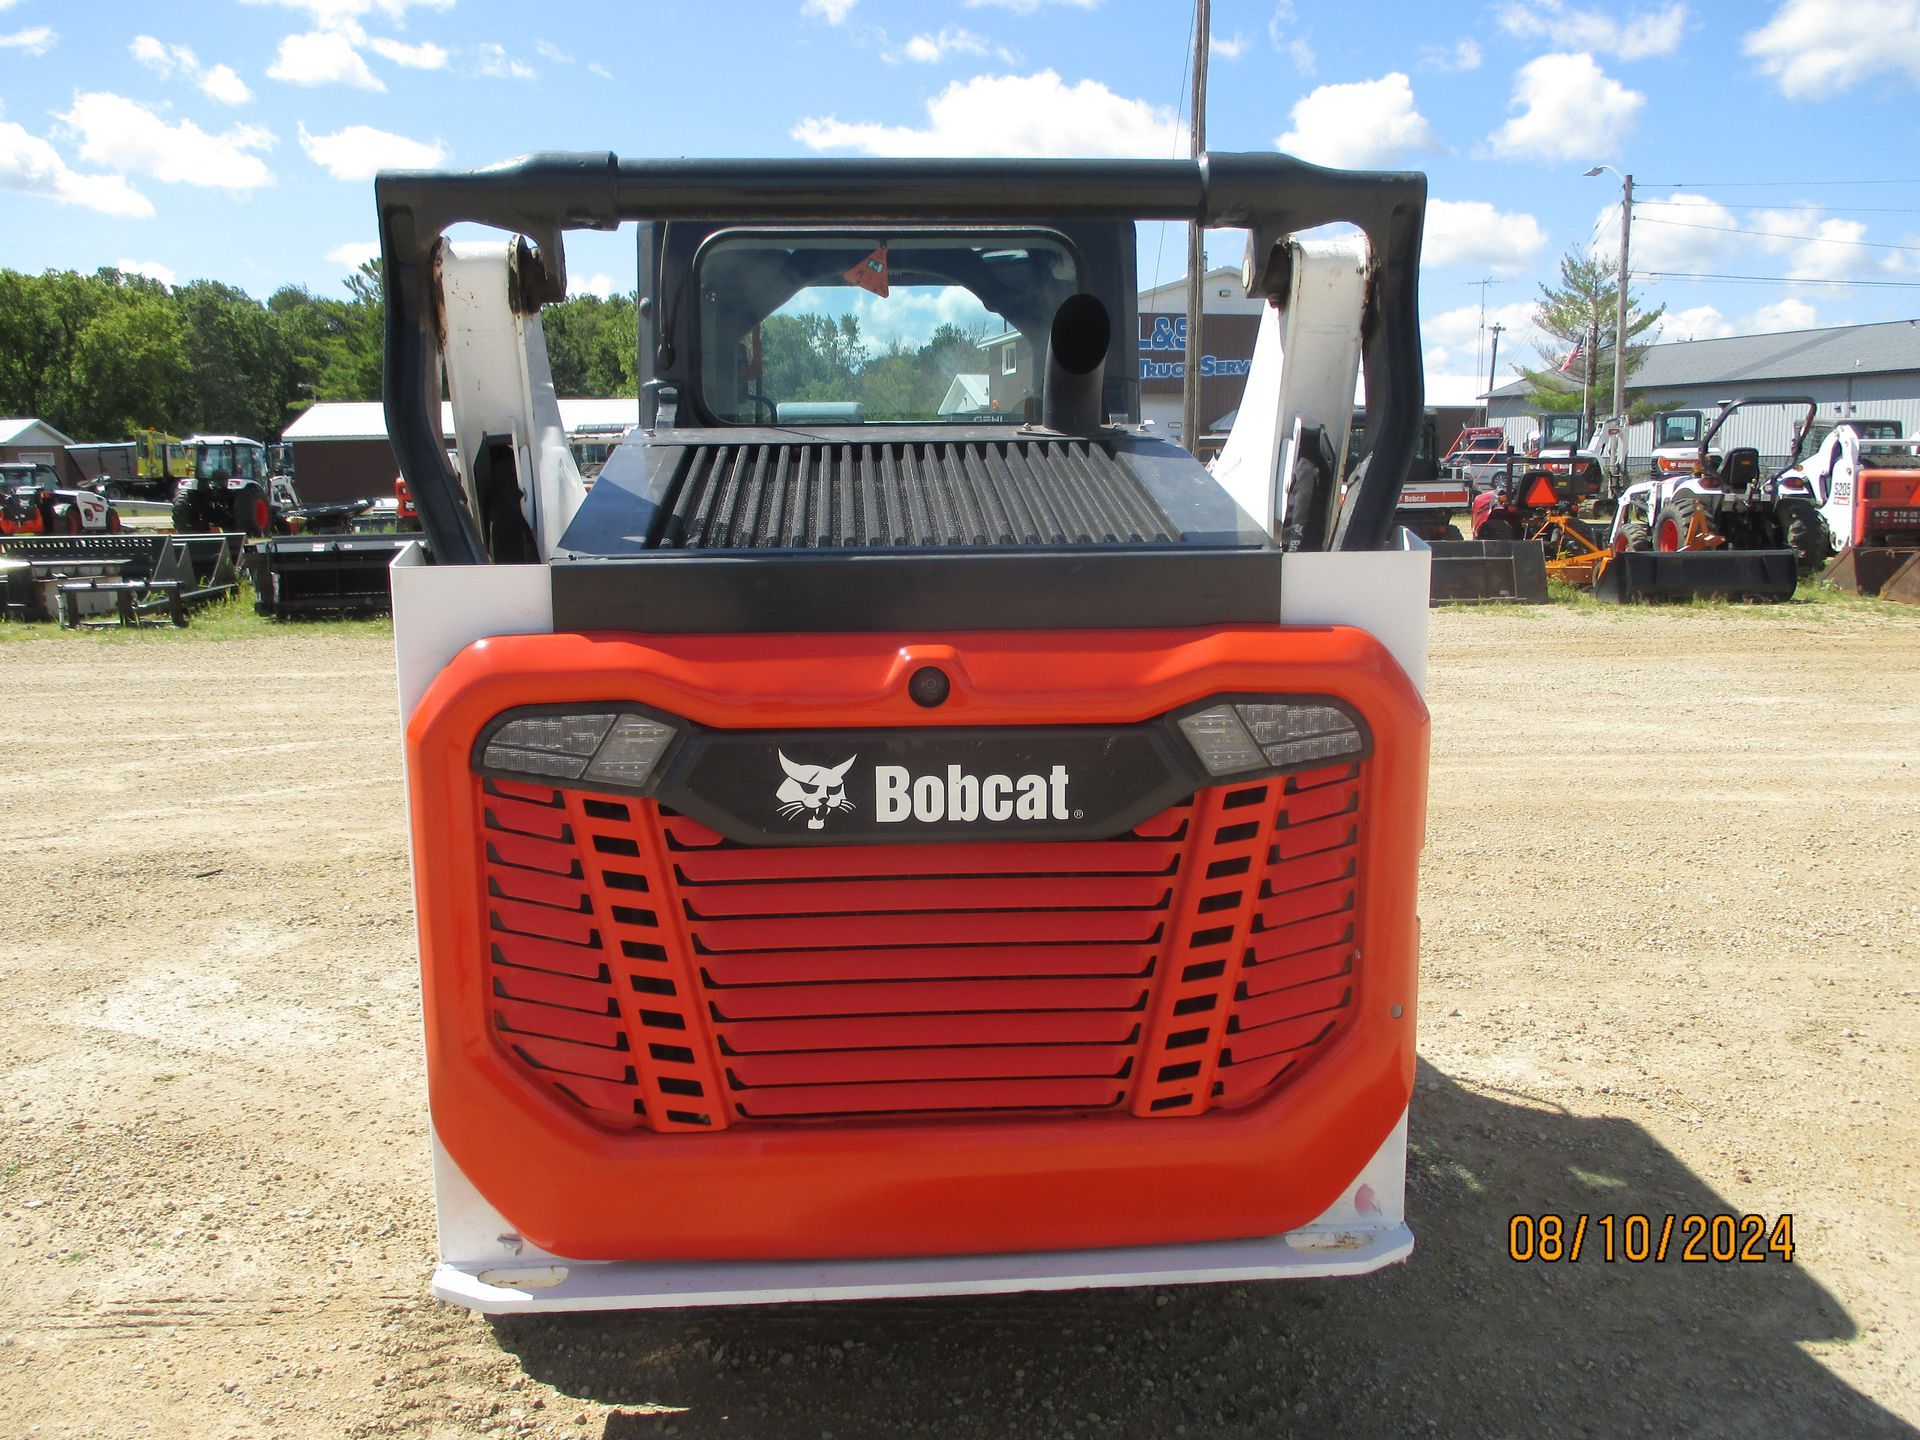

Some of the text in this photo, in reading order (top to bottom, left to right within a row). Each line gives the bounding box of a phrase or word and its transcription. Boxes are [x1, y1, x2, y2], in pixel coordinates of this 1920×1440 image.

[1139, 354, 1252, 379] TRUC SERV
[1834, 482, 1851, 496] S205
[1404, 495, 1427, 503] Bobcat
[875, 764, 1070, 822] Bobcat
